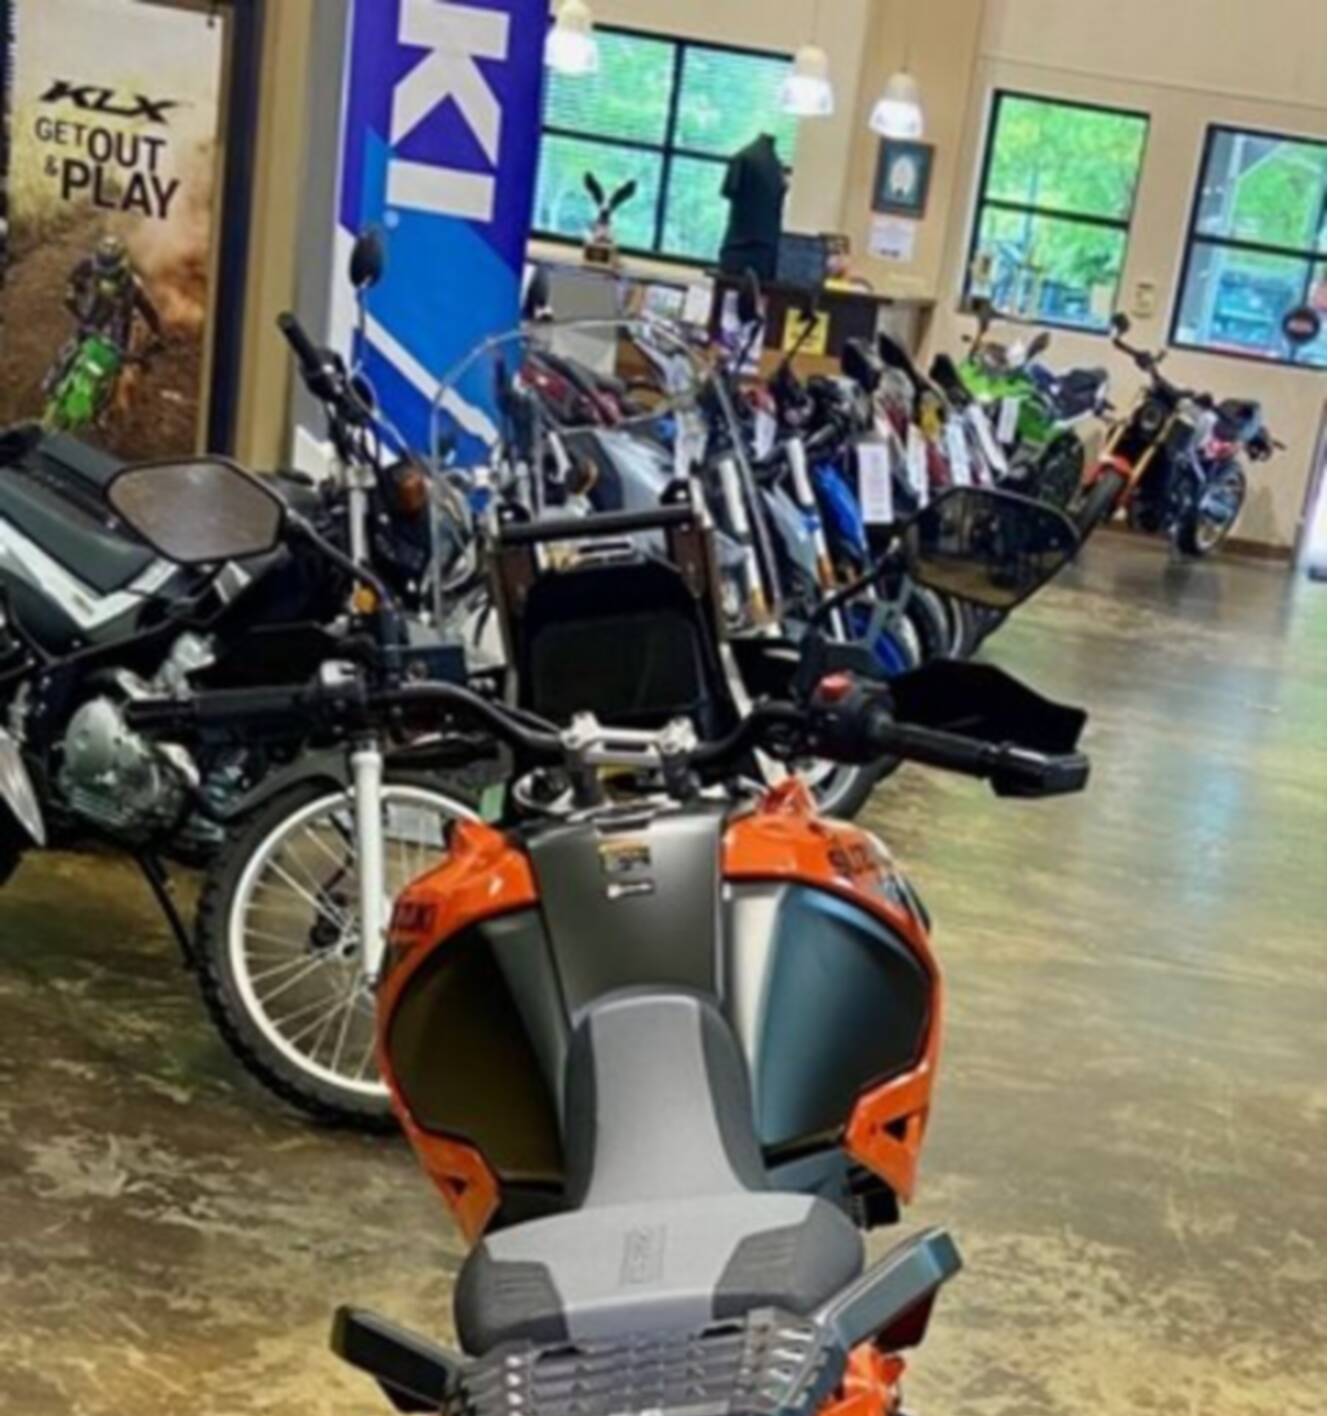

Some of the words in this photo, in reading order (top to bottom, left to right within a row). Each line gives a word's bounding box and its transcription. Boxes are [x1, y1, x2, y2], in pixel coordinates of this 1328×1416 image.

[40, 80, 180, 126] KLX
[34, 116, 86, 148] GET
[87, 126, 167, 173] OUT
[61, 157, 181, 220] PLAY
